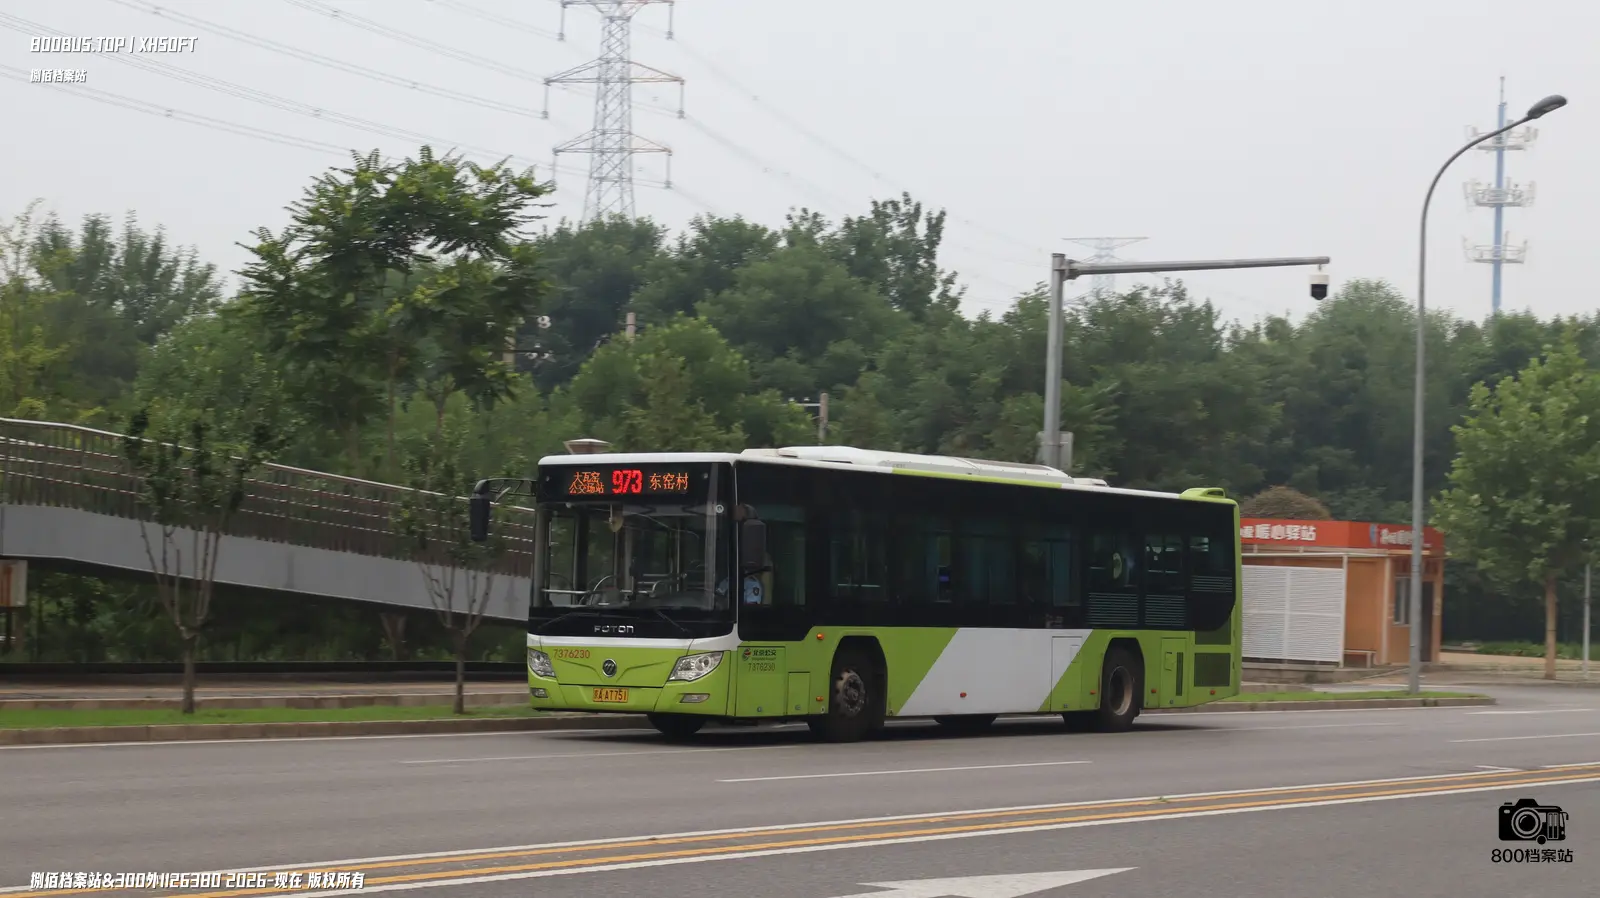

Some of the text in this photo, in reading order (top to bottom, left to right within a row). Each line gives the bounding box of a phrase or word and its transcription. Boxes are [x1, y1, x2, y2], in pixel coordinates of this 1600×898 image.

[573, 471, 601, 483] 大瓦窑
[611, 469, 643, 494] 973
[649, 472, 689, 491] 东窑村
[568, 482, 605, 495] 公交场站
[594, 625, 634, 634] FOTON
[553, 648, 591, 660] 7376230
[747, 662, 776, 673] 7376230
